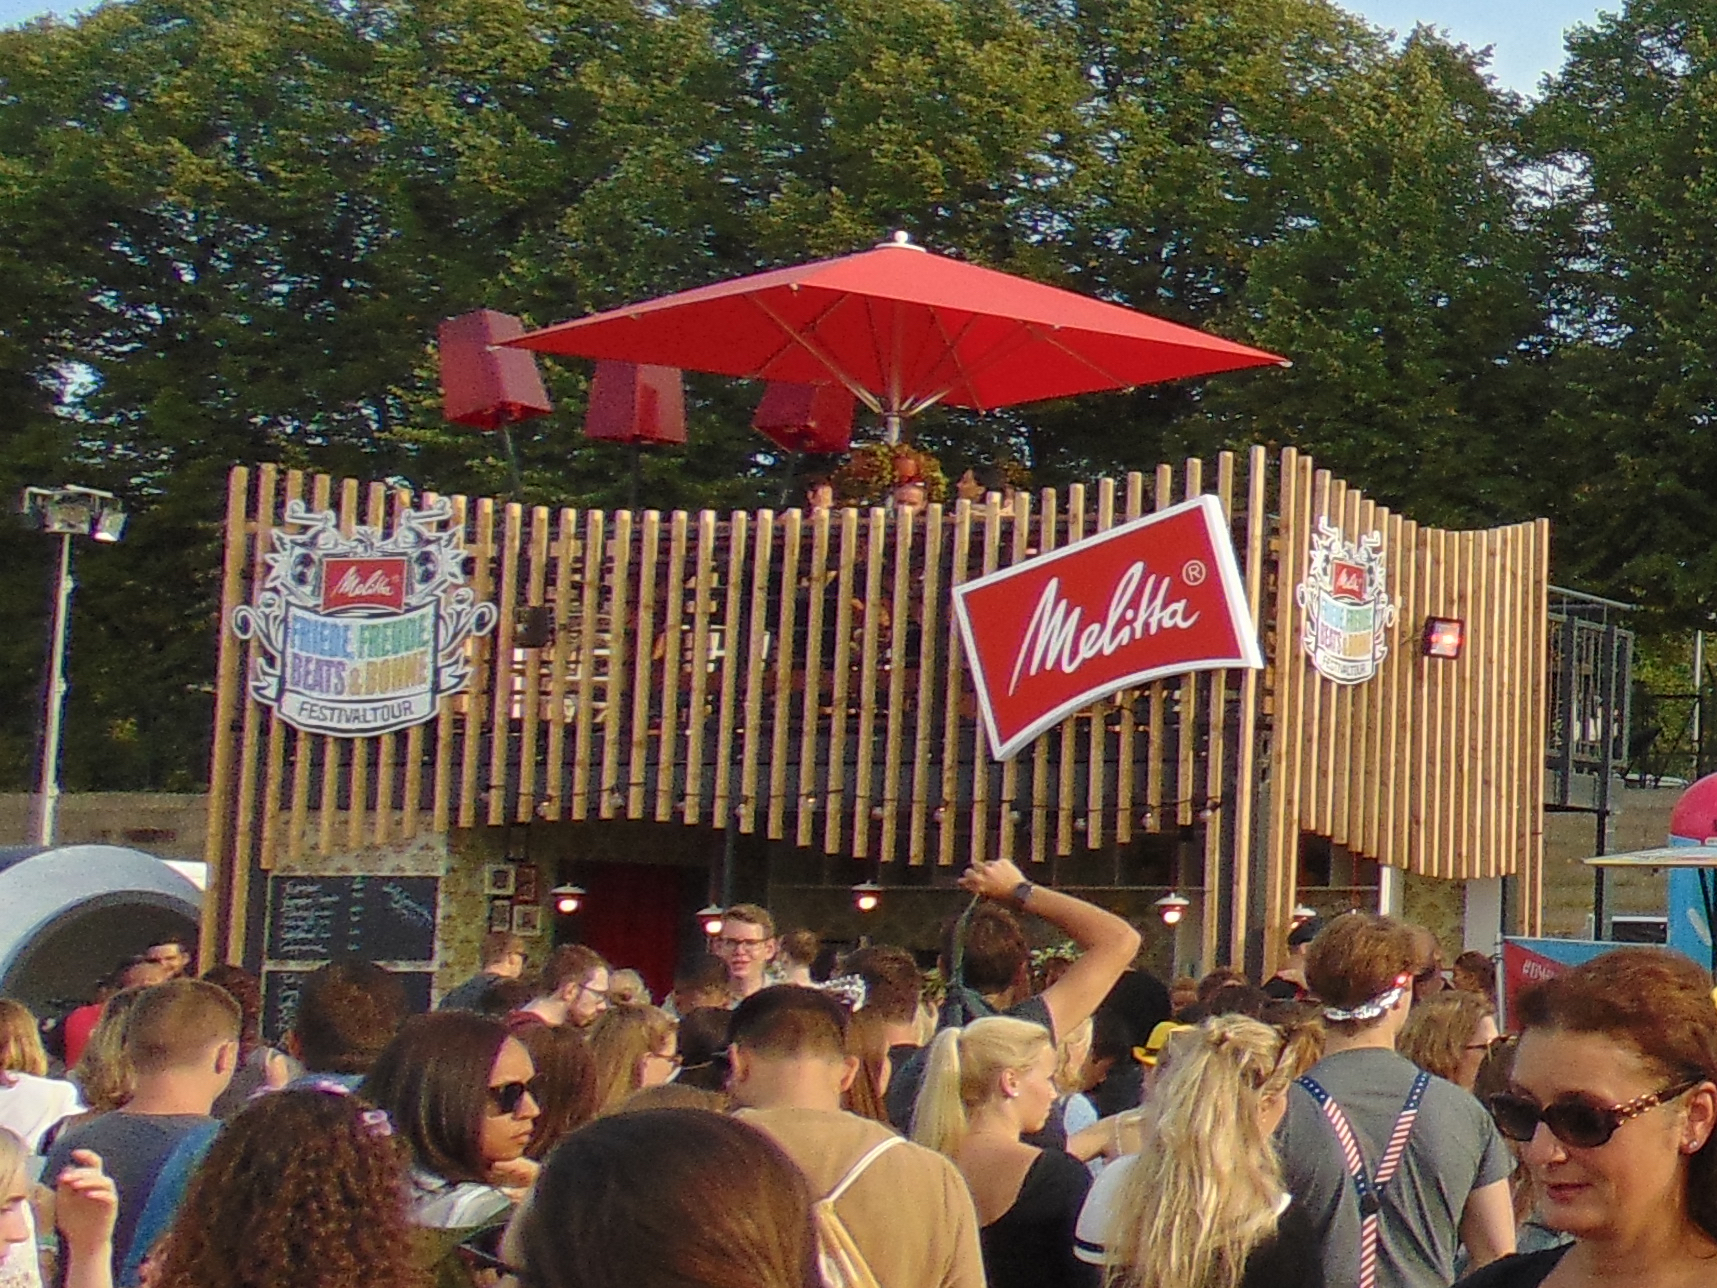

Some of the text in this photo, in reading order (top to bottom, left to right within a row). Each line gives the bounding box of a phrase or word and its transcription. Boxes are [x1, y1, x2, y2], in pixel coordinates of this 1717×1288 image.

[332, 565, 396, 597] Melitta
[1007, 560, 1200, 697] Melitta
[292, 652, 347, 696] BEATS
[299, 699, 415, 724] FESTIVALTOUR
